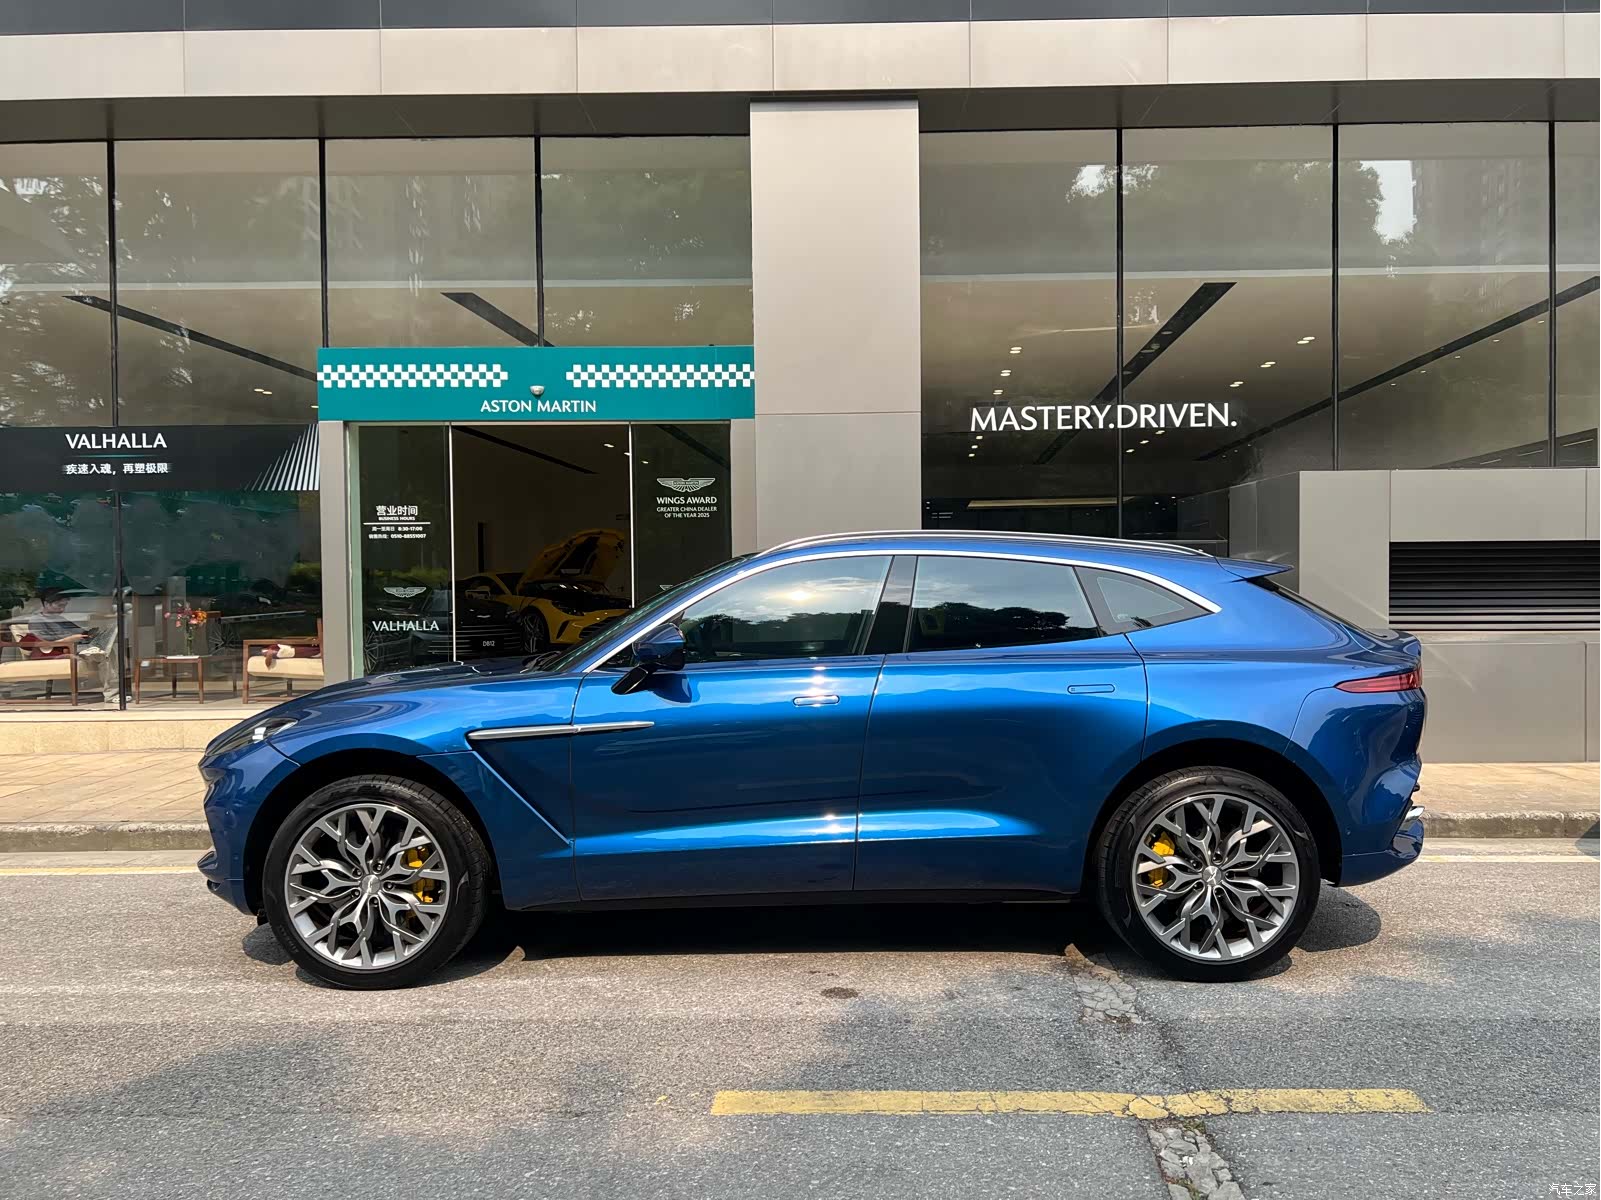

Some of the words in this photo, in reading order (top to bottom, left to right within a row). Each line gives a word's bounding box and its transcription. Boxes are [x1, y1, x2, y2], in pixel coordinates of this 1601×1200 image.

[480, 400, 532, 413] ASTON
[537, 400, 597, 413] MARTIN
[970, 403, 1238, 432] MASTERY.DRIVEN.
[65, 432, 168, 449] VALHALLA
[656, 496, 686, 505] WINGS
[686, 496, 718, 504] AWARD
[375, 505, 418, 516] 营业时间
[372, 620, 440, 631] VALHALLA
